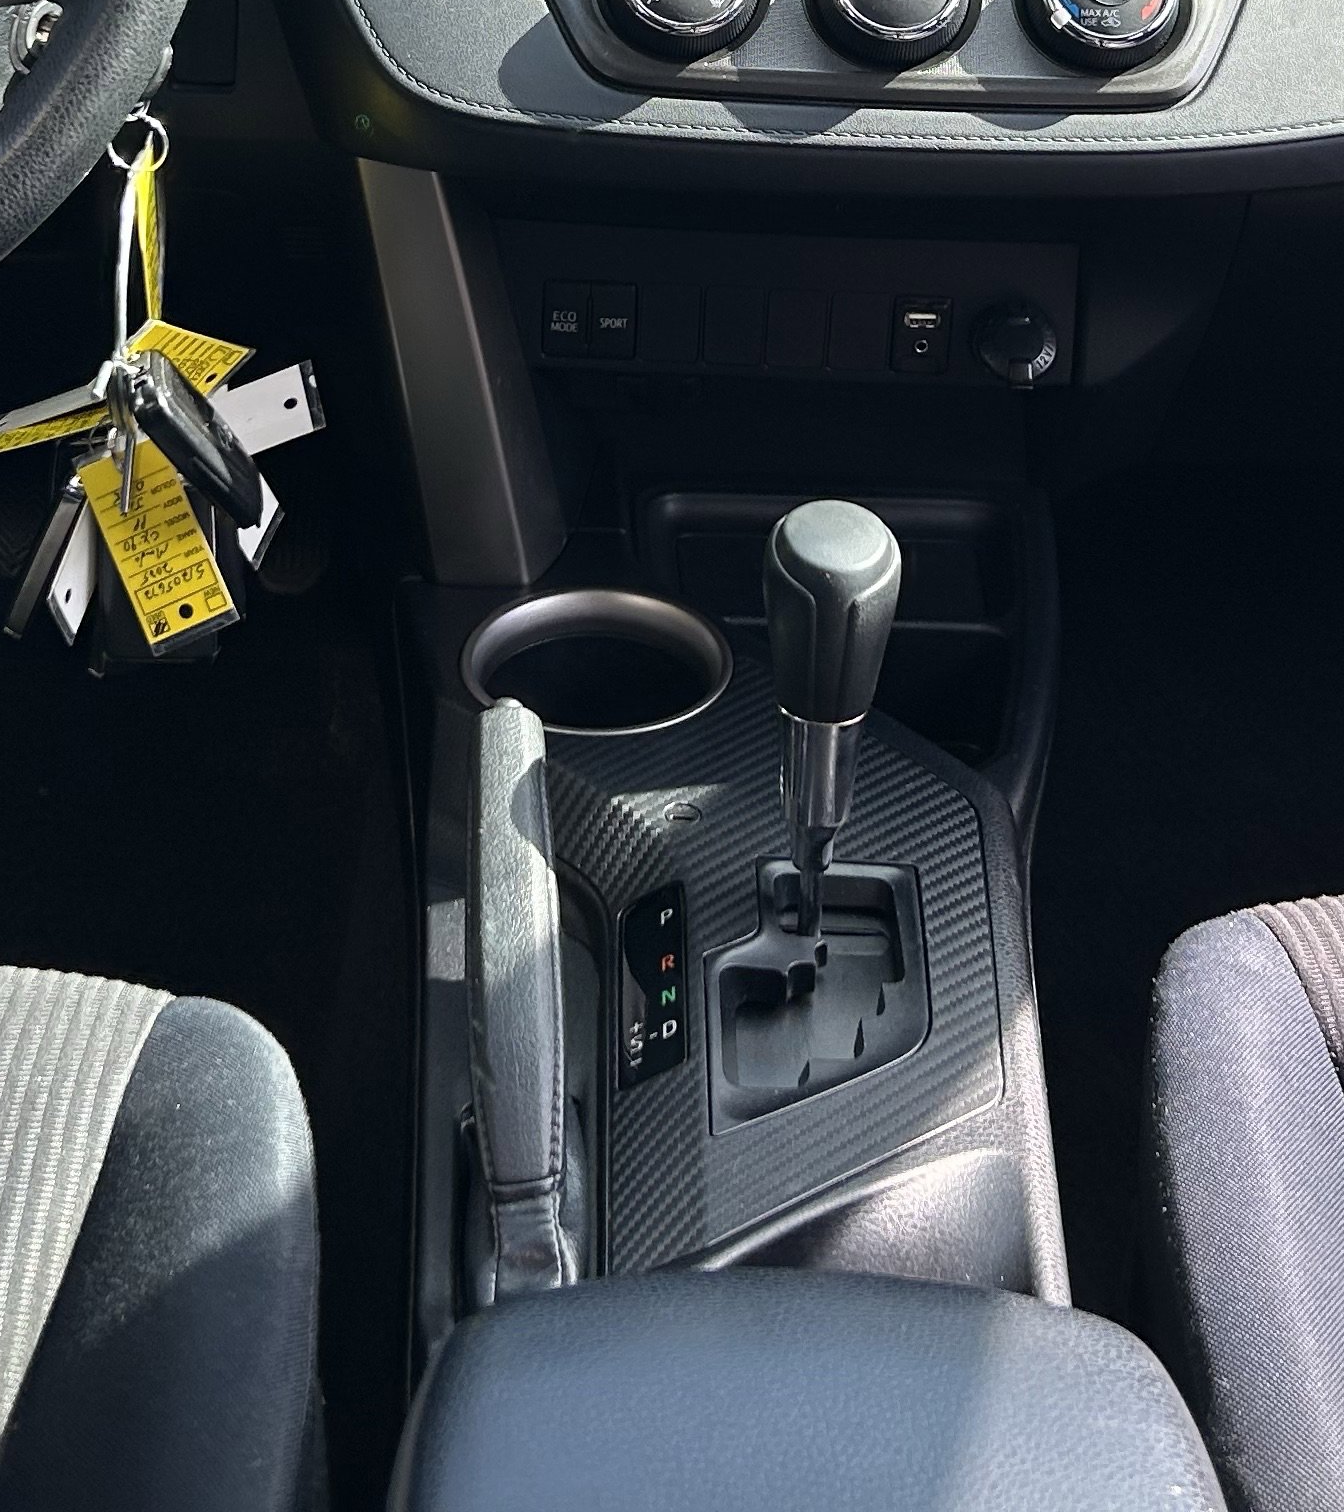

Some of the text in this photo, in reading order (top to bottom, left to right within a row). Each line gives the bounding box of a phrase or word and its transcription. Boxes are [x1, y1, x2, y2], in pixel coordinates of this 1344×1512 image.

[1080, 8, 1120, 18] MAX A/C
[1080, 17, 1098, 27] USE
[552, 310, 577, 322] ECO
[550, 321, 579, 333] MODE
[599, 317, 629, 329] SPORT
[660, 908, 673, 927] P
[661, 954, 676, 973] R
[661, 985, 676, 1007] N
[662, 1019, 677, 1040] D
